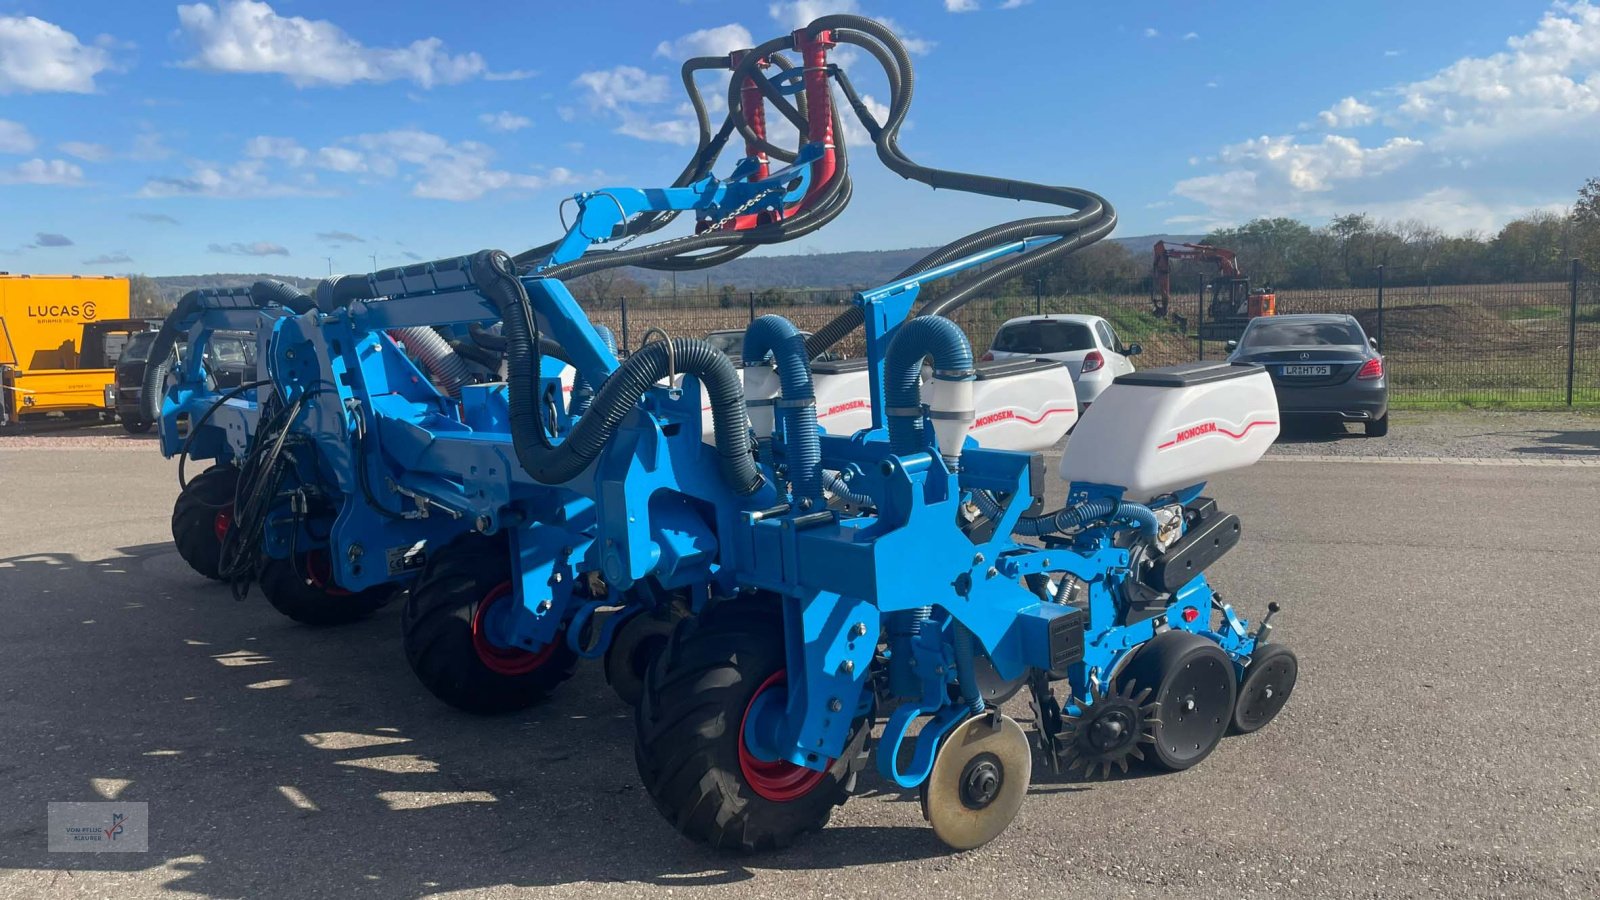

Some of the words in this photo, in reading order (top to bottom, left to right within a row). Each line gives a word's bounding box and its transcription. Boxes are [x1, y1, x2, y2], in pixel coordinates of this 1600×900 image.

[28, 305, 80, 317] LUCAS
[1286, 366, 1297, 374] LR
[1303, 366, 1314, 374] HT
[1316, 366, 1327, 374] 95
[828, 400, 865, 416] MONOSEM
[975, 410, 1015, 428] MONOSEM
[1176, 422, 1217, 443] MONOSEM
